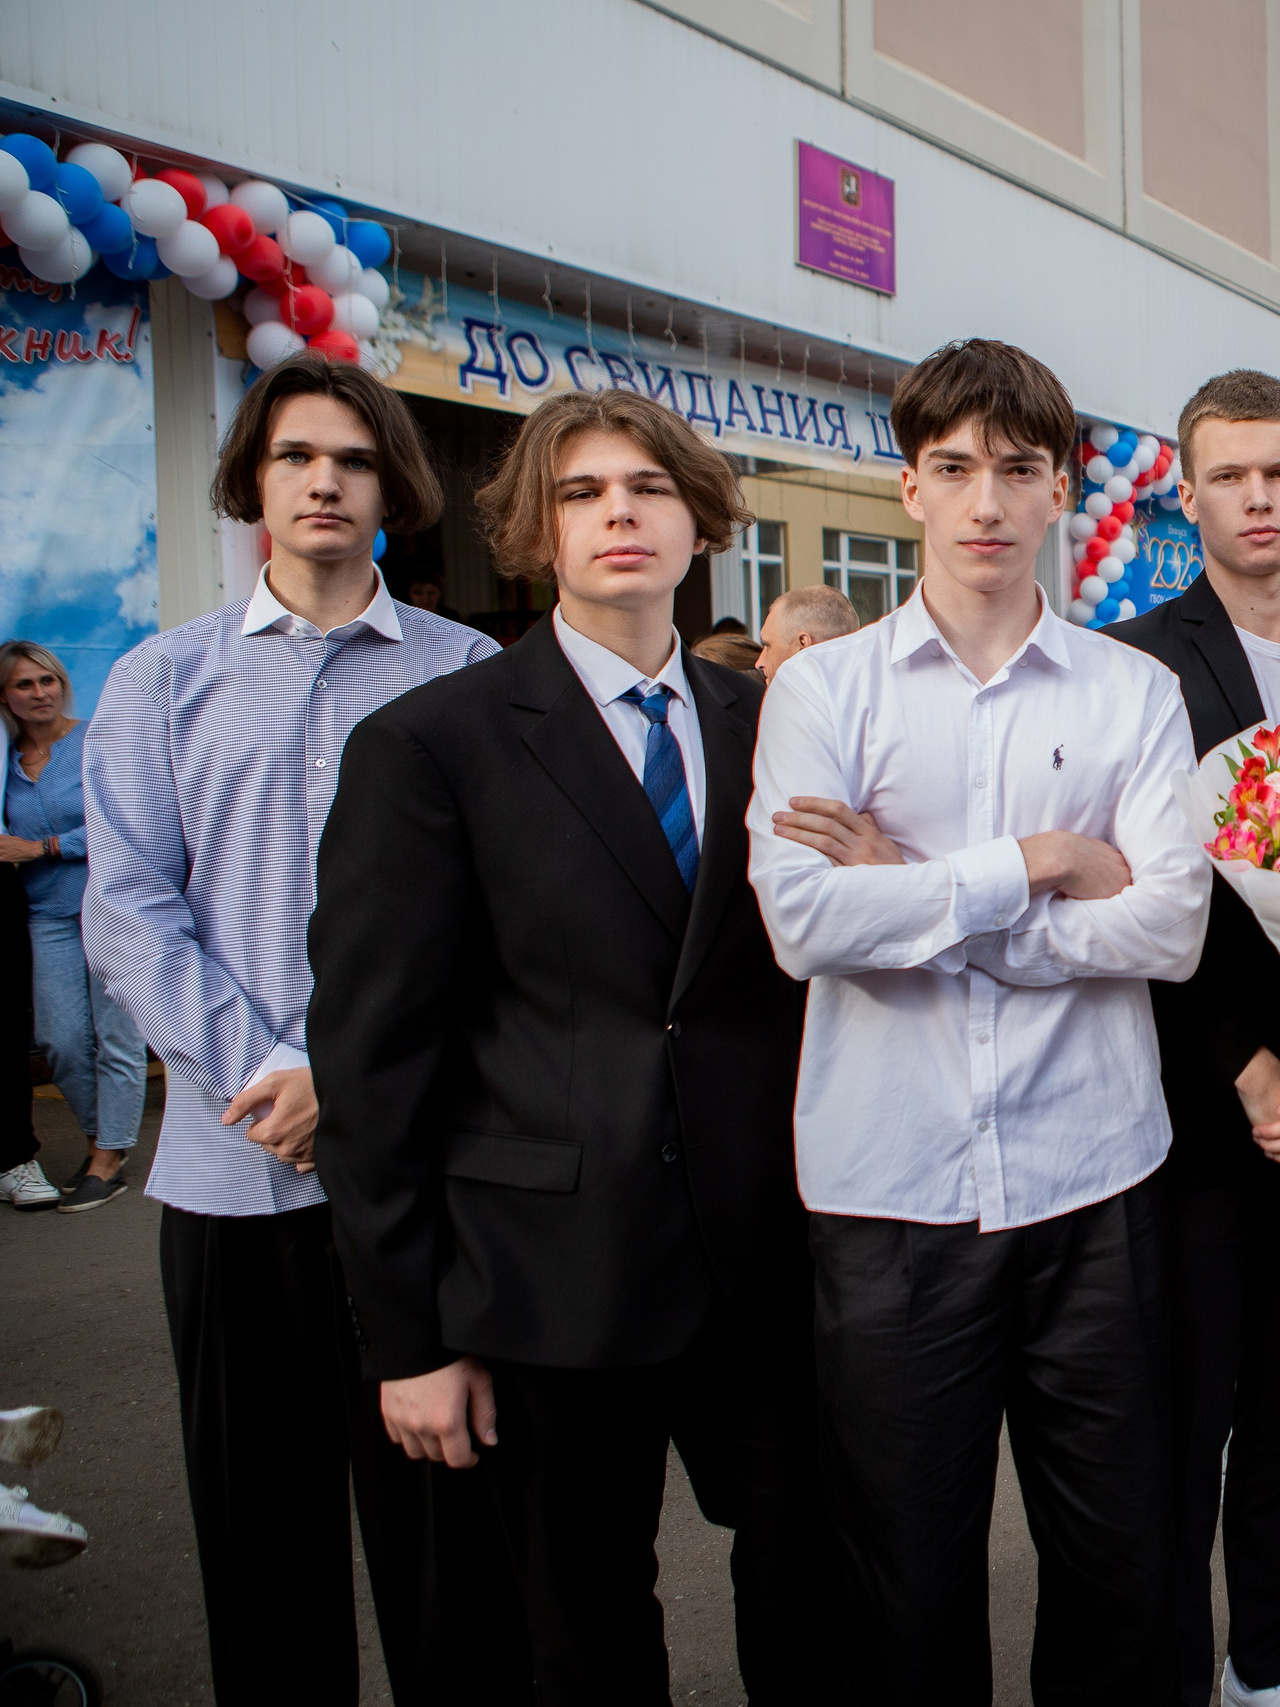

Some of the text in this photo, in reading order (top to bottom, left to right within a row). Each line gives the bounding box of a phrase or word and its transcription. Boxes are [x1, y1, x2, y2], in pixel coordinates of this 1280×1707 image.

[460, 316, 552, 396] ДО
[565, 345, 862, 463] СВИДАНИЯ,
[1148, 536, 1205, 592] 2025
